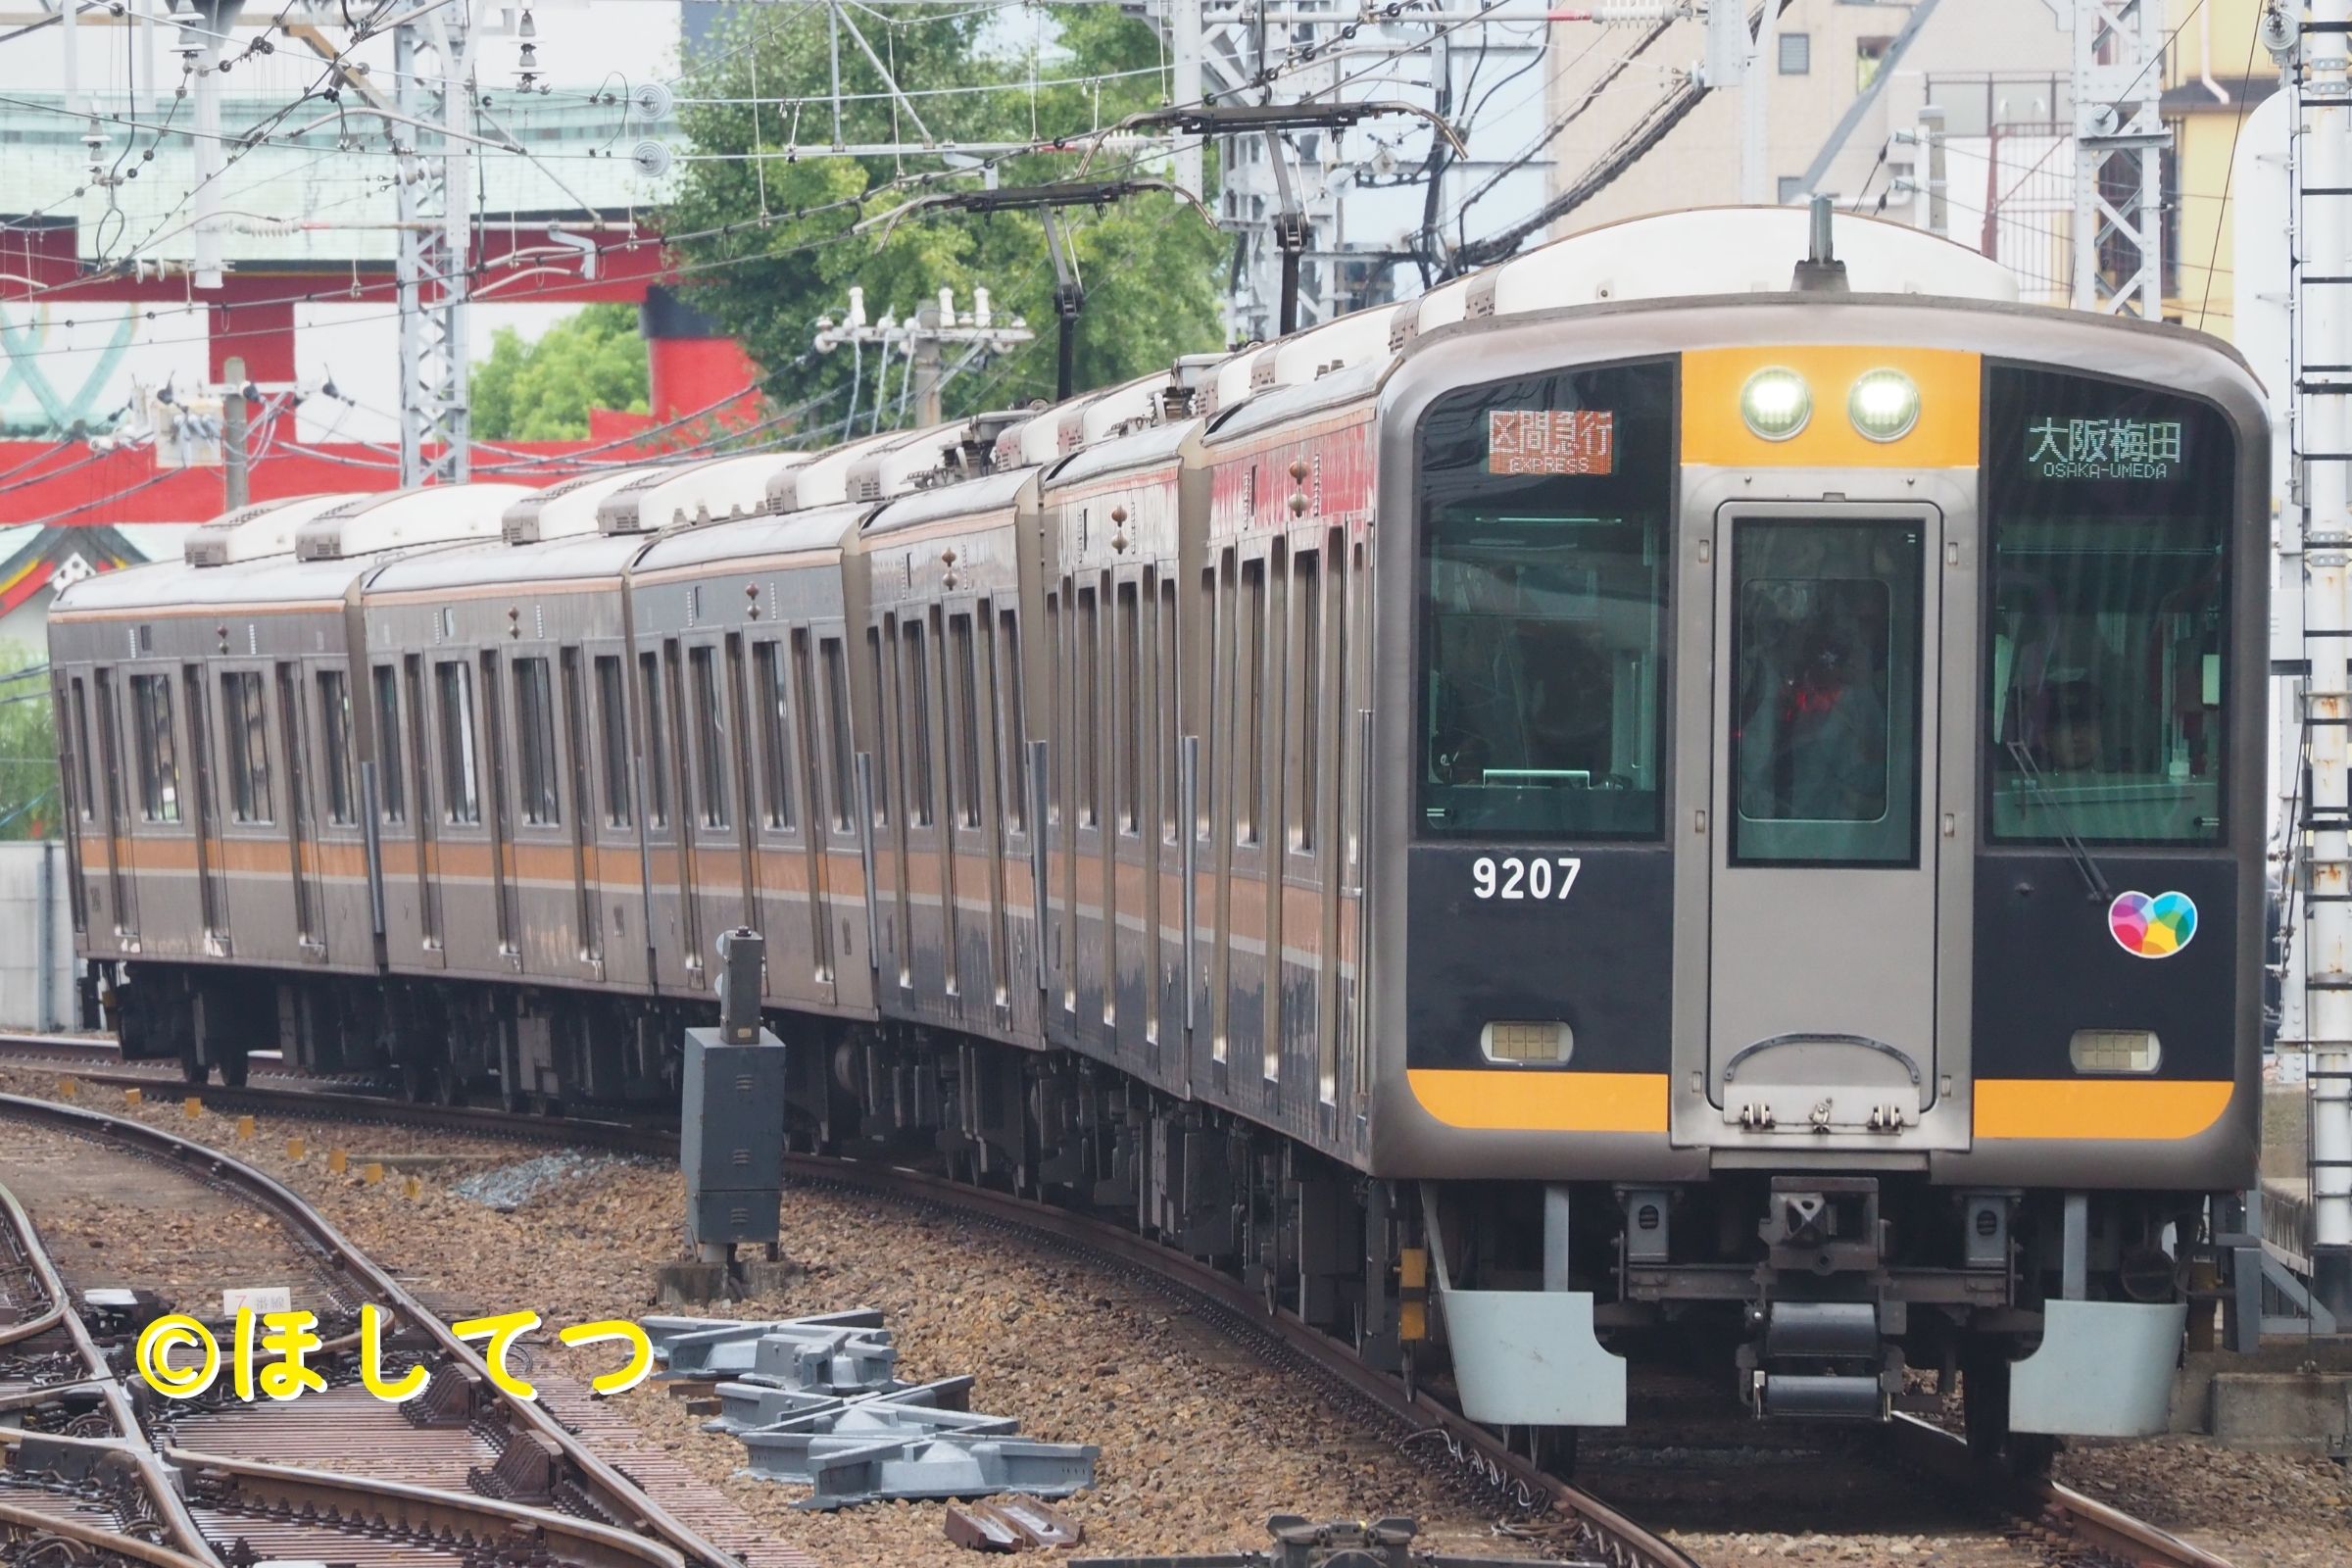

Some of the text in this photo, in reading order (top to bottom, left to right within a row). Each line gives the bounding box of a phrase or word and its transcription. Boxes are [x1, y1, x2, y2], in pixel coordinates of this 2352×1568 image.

[1490, 411, 1612, 455] 区間急行
[2029, 417, 2180, 463] 大阪梅田
[1510, 458, 1589, 472] EXPRESS
[2043, 463, 2167, 478] OSAKA-UMEDA
[1473, 858, 1581, 899] 9207
